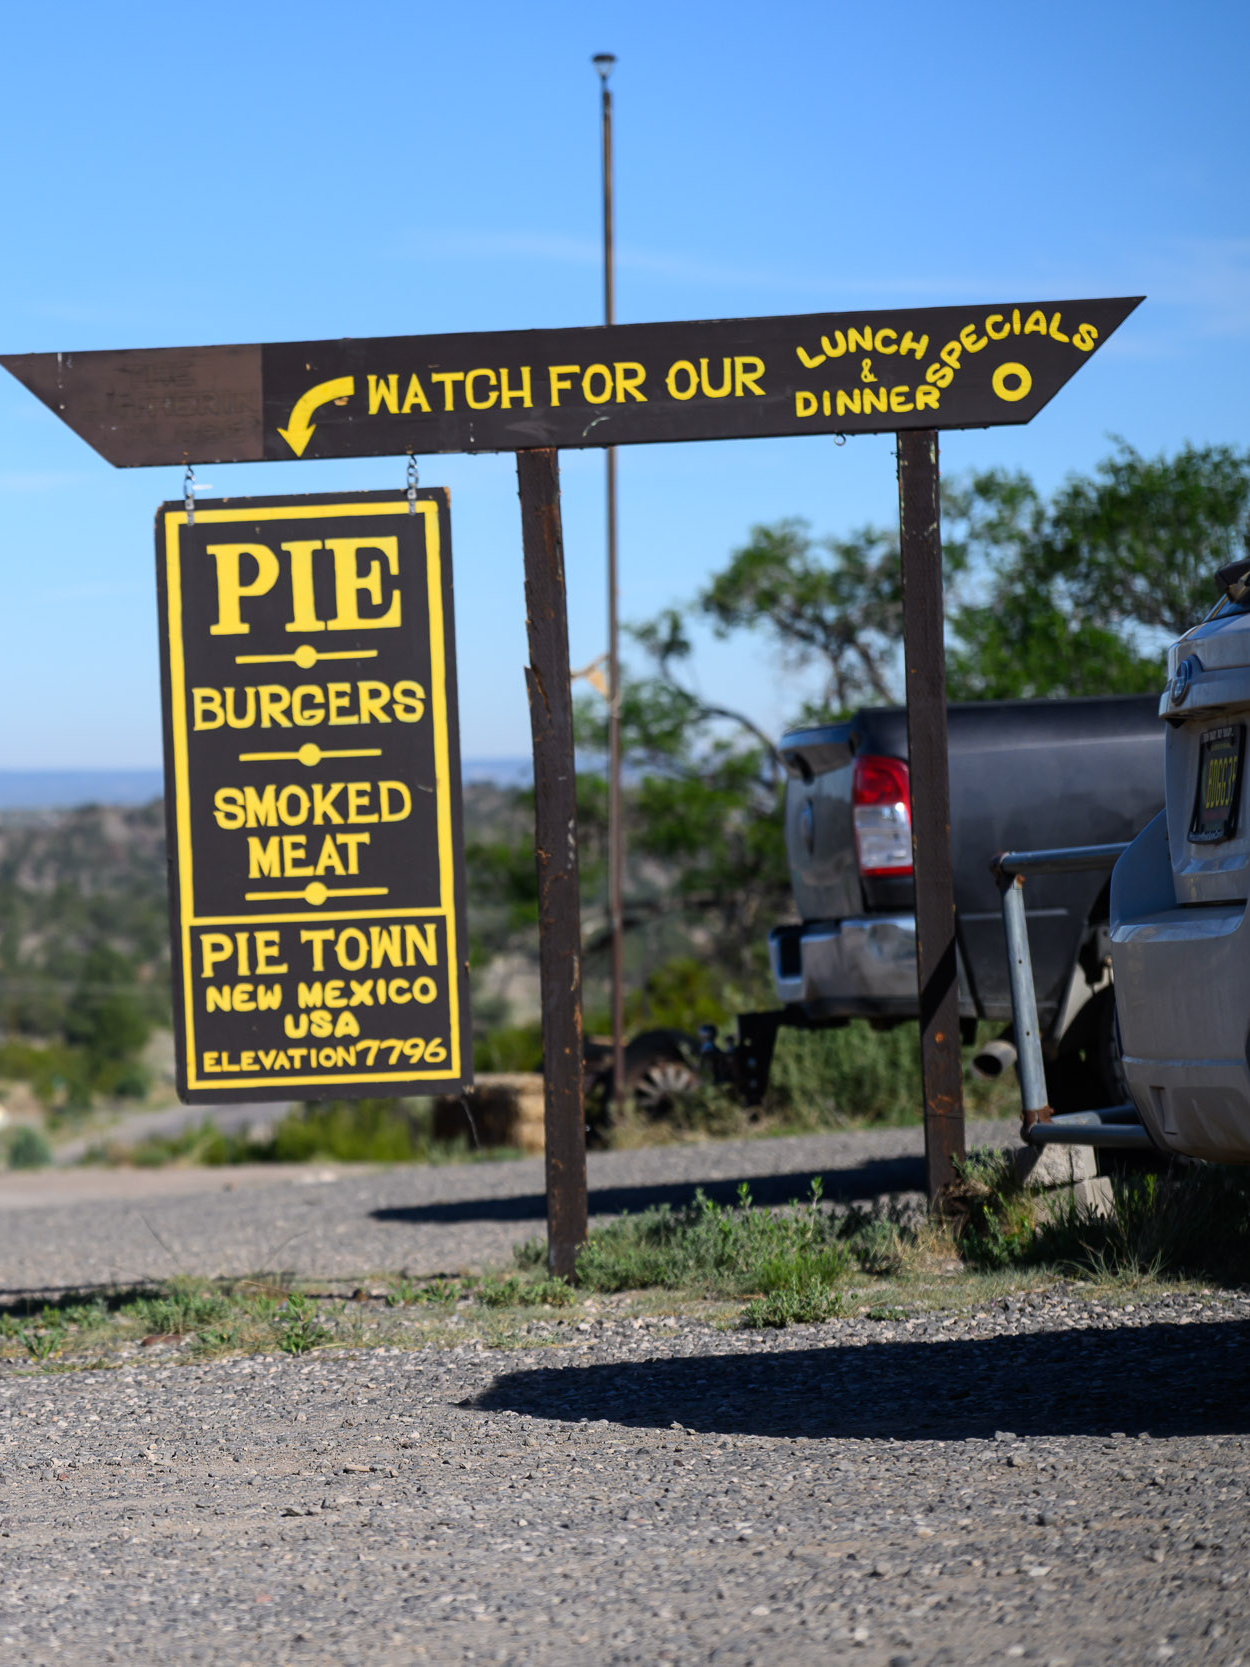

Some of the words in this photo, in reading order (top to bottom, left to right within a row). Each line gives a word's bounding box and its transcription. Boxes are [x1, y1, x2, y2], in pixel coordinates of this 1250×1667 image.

[797, 326, 928, 368] LUNCH
[926, 309, 1098, 388] SPECIALS
[367, 367, 533, 414] WATCH
[549, 362, 647, 406] FOR
[666, 356, 766, 400] OUR
[861, 359, 877, 382] &
[796, 385, 940, 417] DINNER
[206, 536, 401, 635] PIE
[192, 681, 425, 730] BURGERS
[214, 781, 411, 829] SMOKED
[248, 832, 370, 878] MEAT
[200, 931, 288, 977] PIE
[300, 924, 437, 971] TOWN
[206, 983, 282, 1012] NEW
[298, 976, 437, 1008] MEXICO
[284, 1010, 360, 1038] USA
[203, 1046, 356, 1072] ELEVATION
[355, 1037, 447, 1066] 7796
